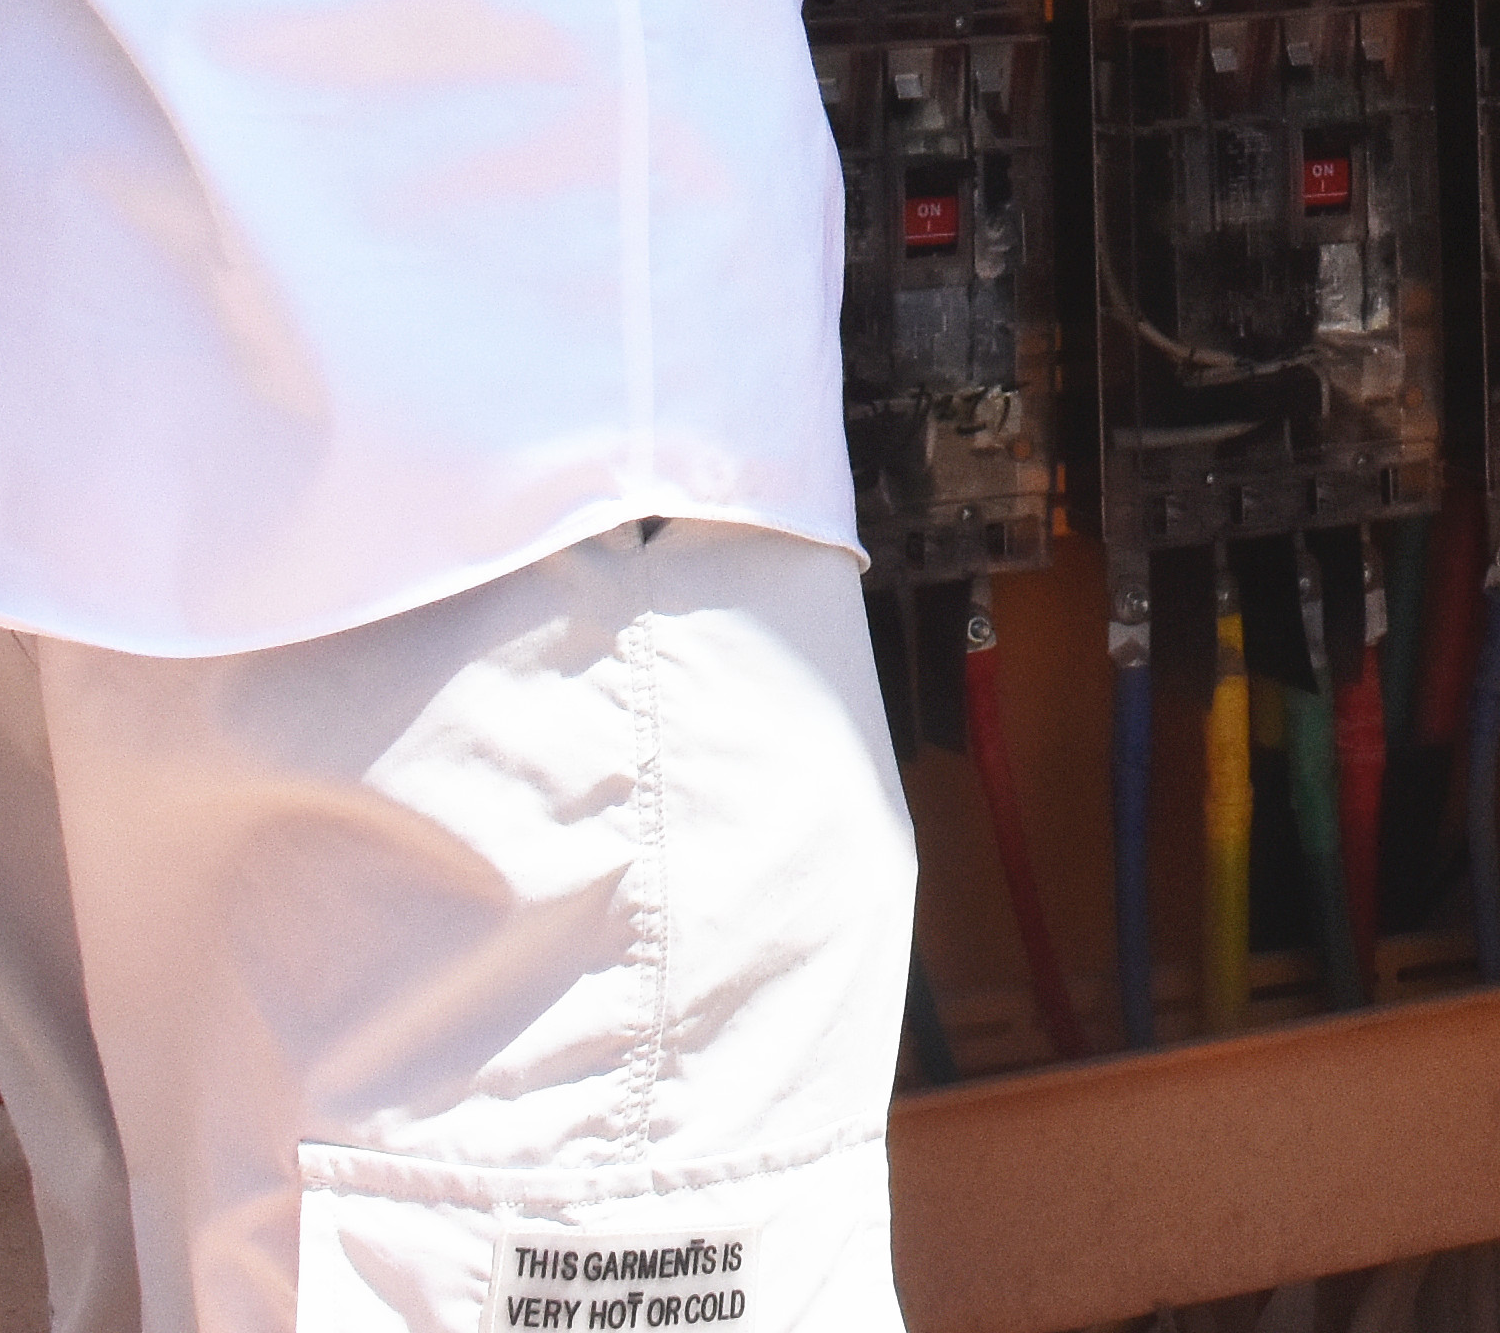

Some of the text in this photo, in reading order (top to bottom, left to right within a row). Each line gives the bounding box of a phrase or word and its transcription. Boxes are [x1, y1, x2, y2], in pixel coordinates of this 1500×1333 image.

[1312, 163, 1335, 177] ON
[917, 203, 941, 218] ON
[515, 1238, 744, 1281] THIS GARMENTS IS
[507, 1289, 746, 1330] VERY HOT OR COLD
